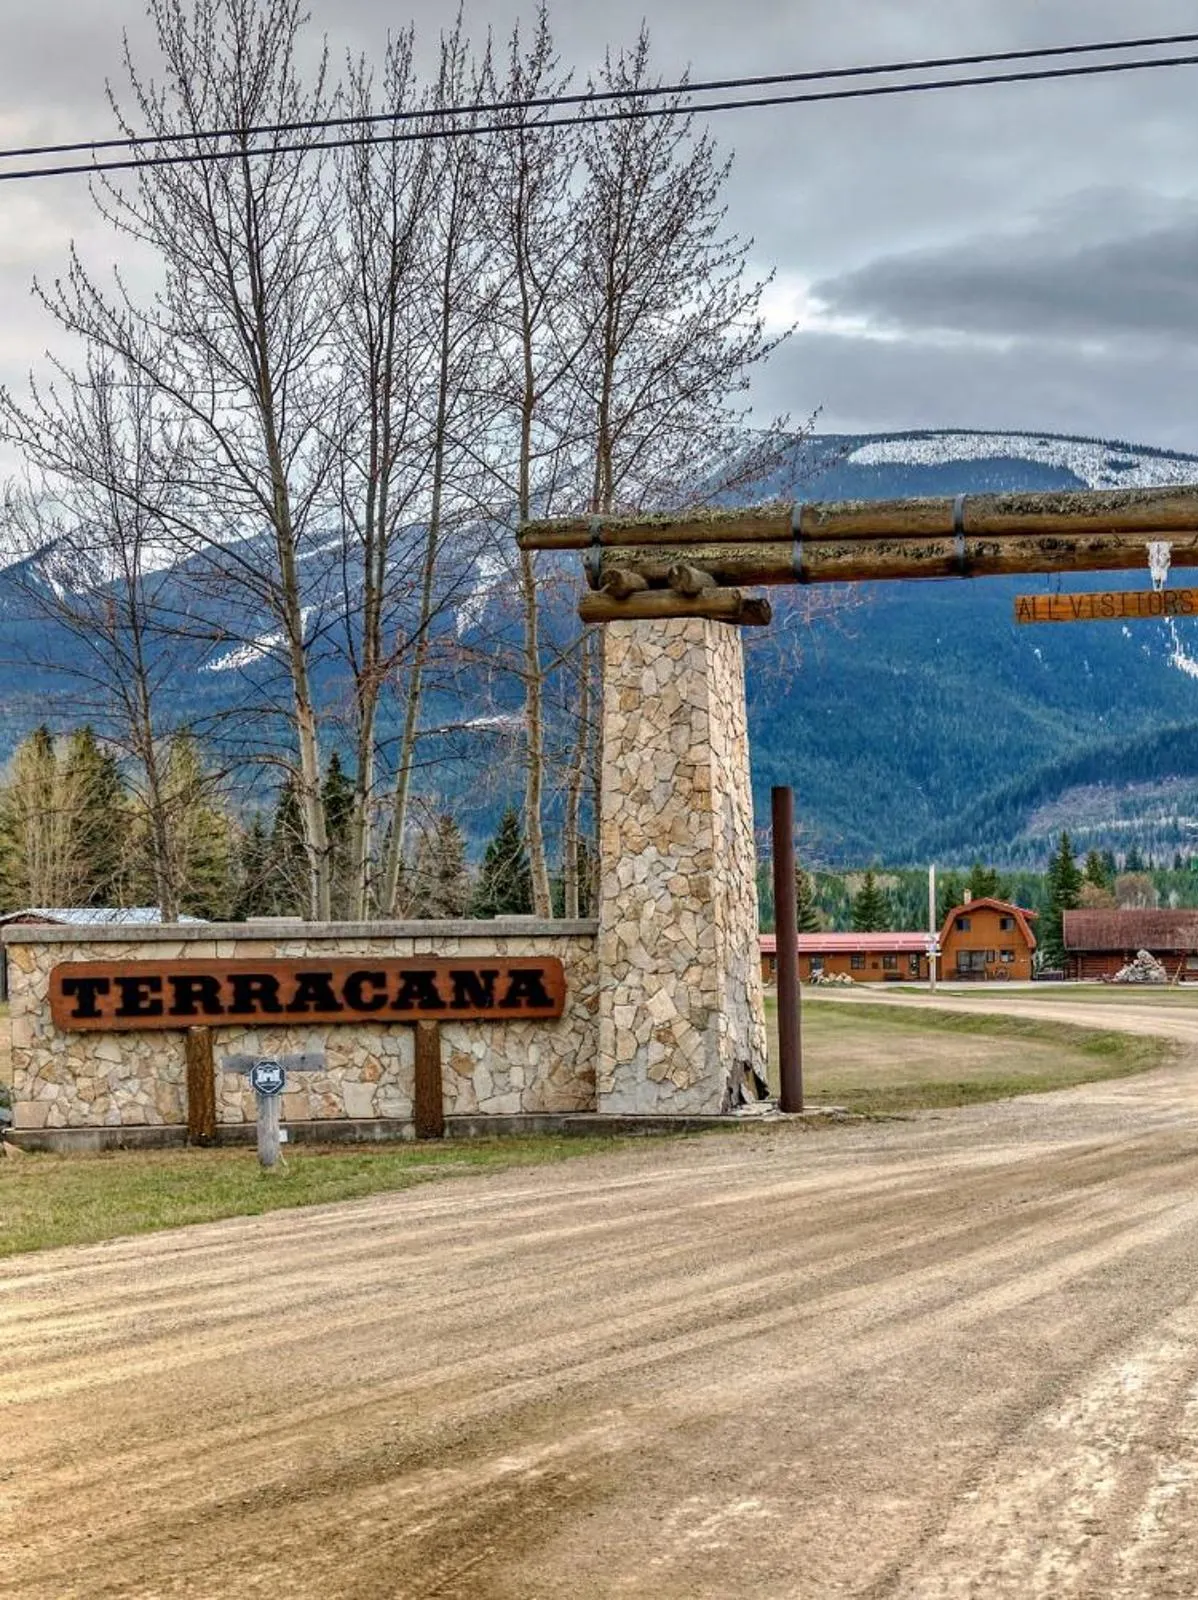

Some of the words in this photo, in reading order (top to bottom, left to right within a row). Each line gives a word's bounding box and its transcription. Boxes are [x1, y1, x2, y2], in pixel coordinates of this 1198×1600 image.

[1018, 596, 1063, 621] ALL
[1068, 590, 1194, 618] VISITORS
[61, 968, 554, 1019] TERRACANA
